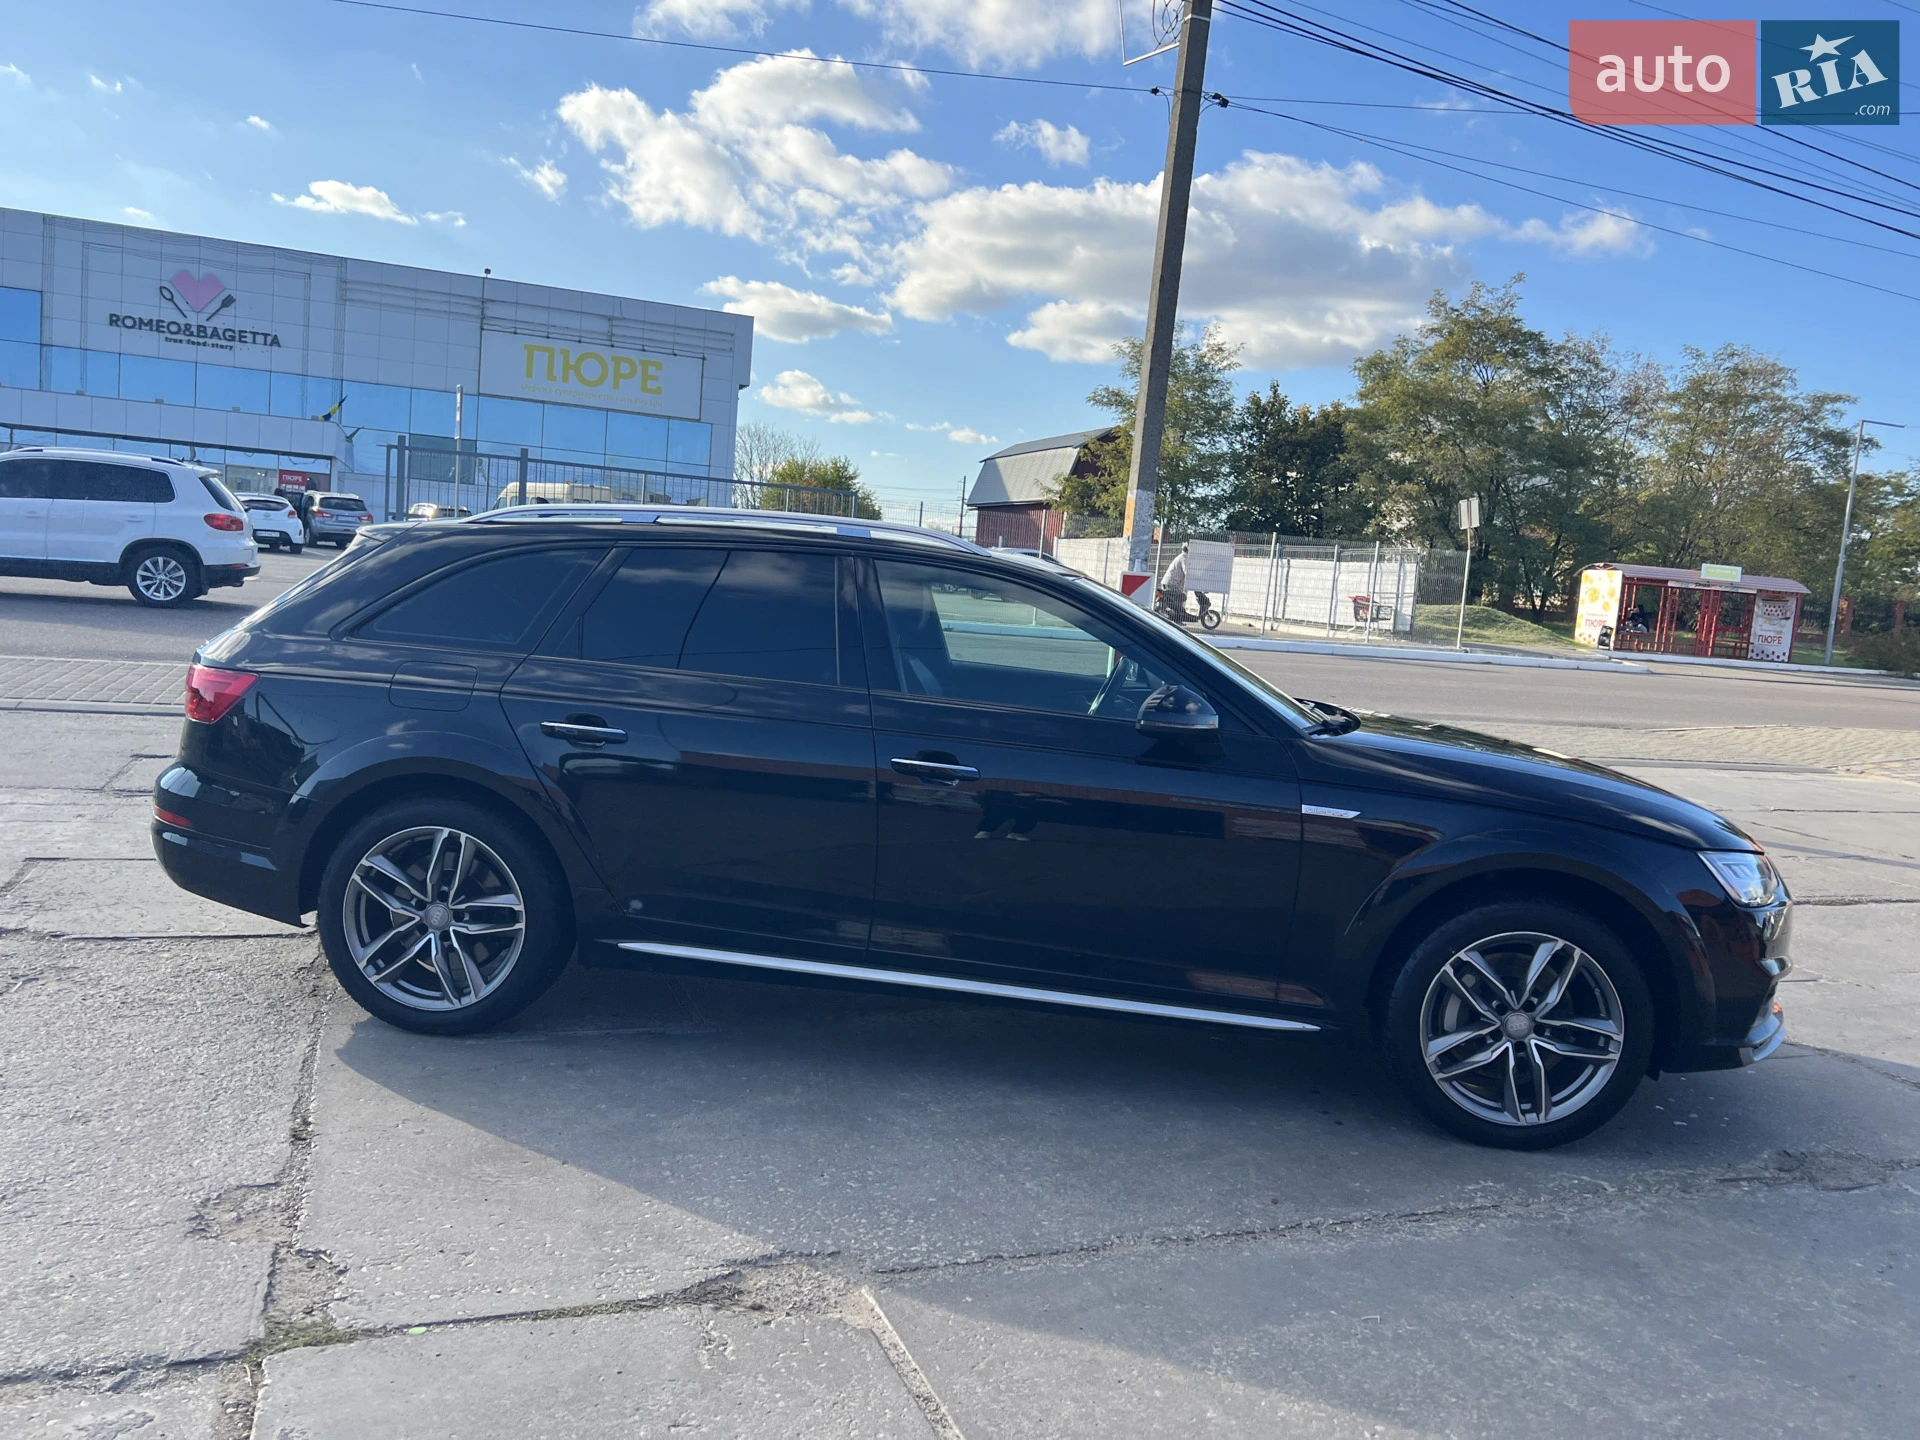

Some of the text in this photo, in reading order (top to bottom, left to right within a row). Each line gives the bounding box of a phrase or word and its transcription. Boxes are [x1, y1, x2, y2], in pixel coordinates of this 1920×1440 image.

[109, 313, 282, 348] ROMEO&BAGETTA
[164, 336, 234, 351] true food story
[523, 343, 664, 395] ПЮРЕ
[282, 474, 303, 482] ПЮРЕ
[1757, 634, 1783, 645] ПЮРЕ
